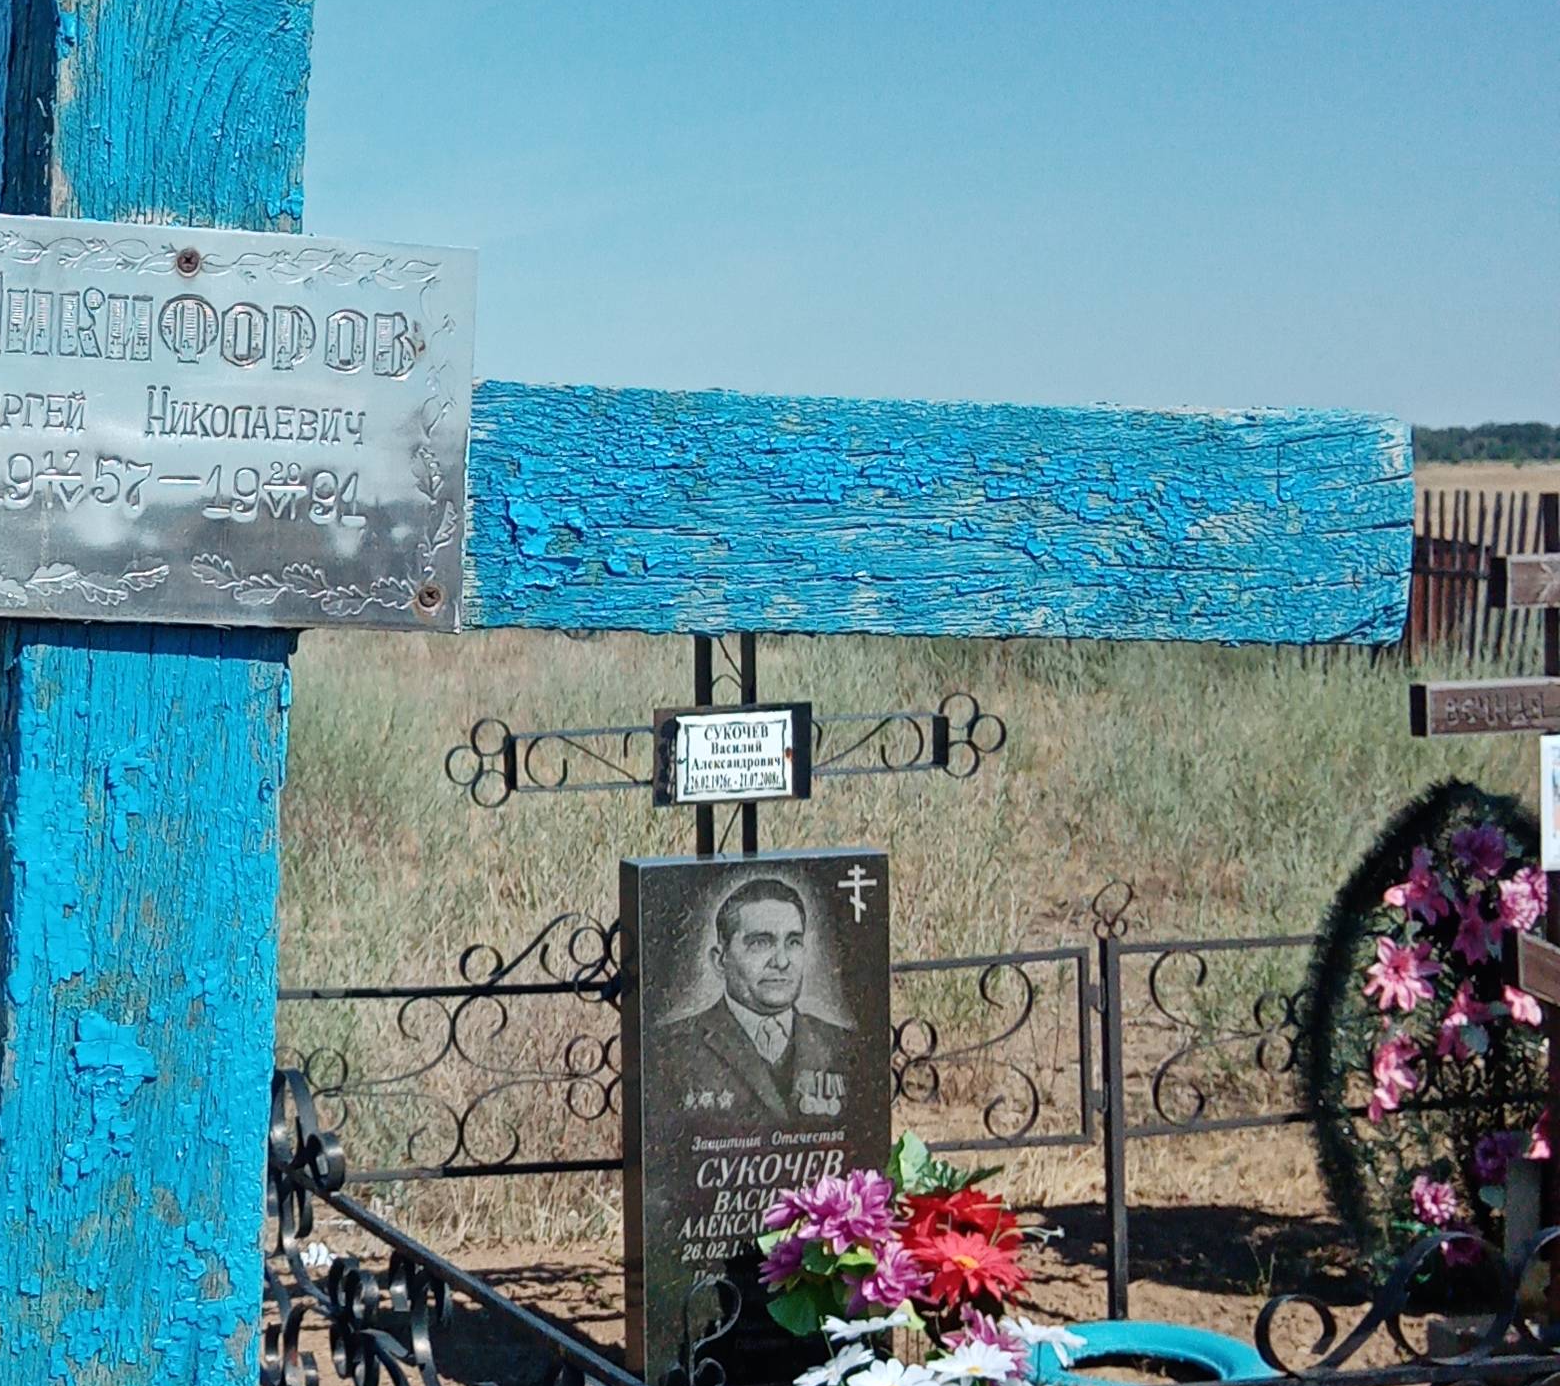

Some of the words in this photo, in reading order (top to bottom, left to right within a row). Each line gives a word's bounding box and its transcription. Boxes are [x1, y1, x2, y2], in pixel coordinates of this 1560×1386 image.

[704, 724, 769, 741] СУКОЧЕВ
[711, 740, 762, 755] Василий
[691, 757, 781, 772] Александрович
[691, 1134, 761, 1152] Защитник
[696, 1149, 845, 1190] СУКОЧЕВ
[713, 1188, 782, 1214] ВАСИ
